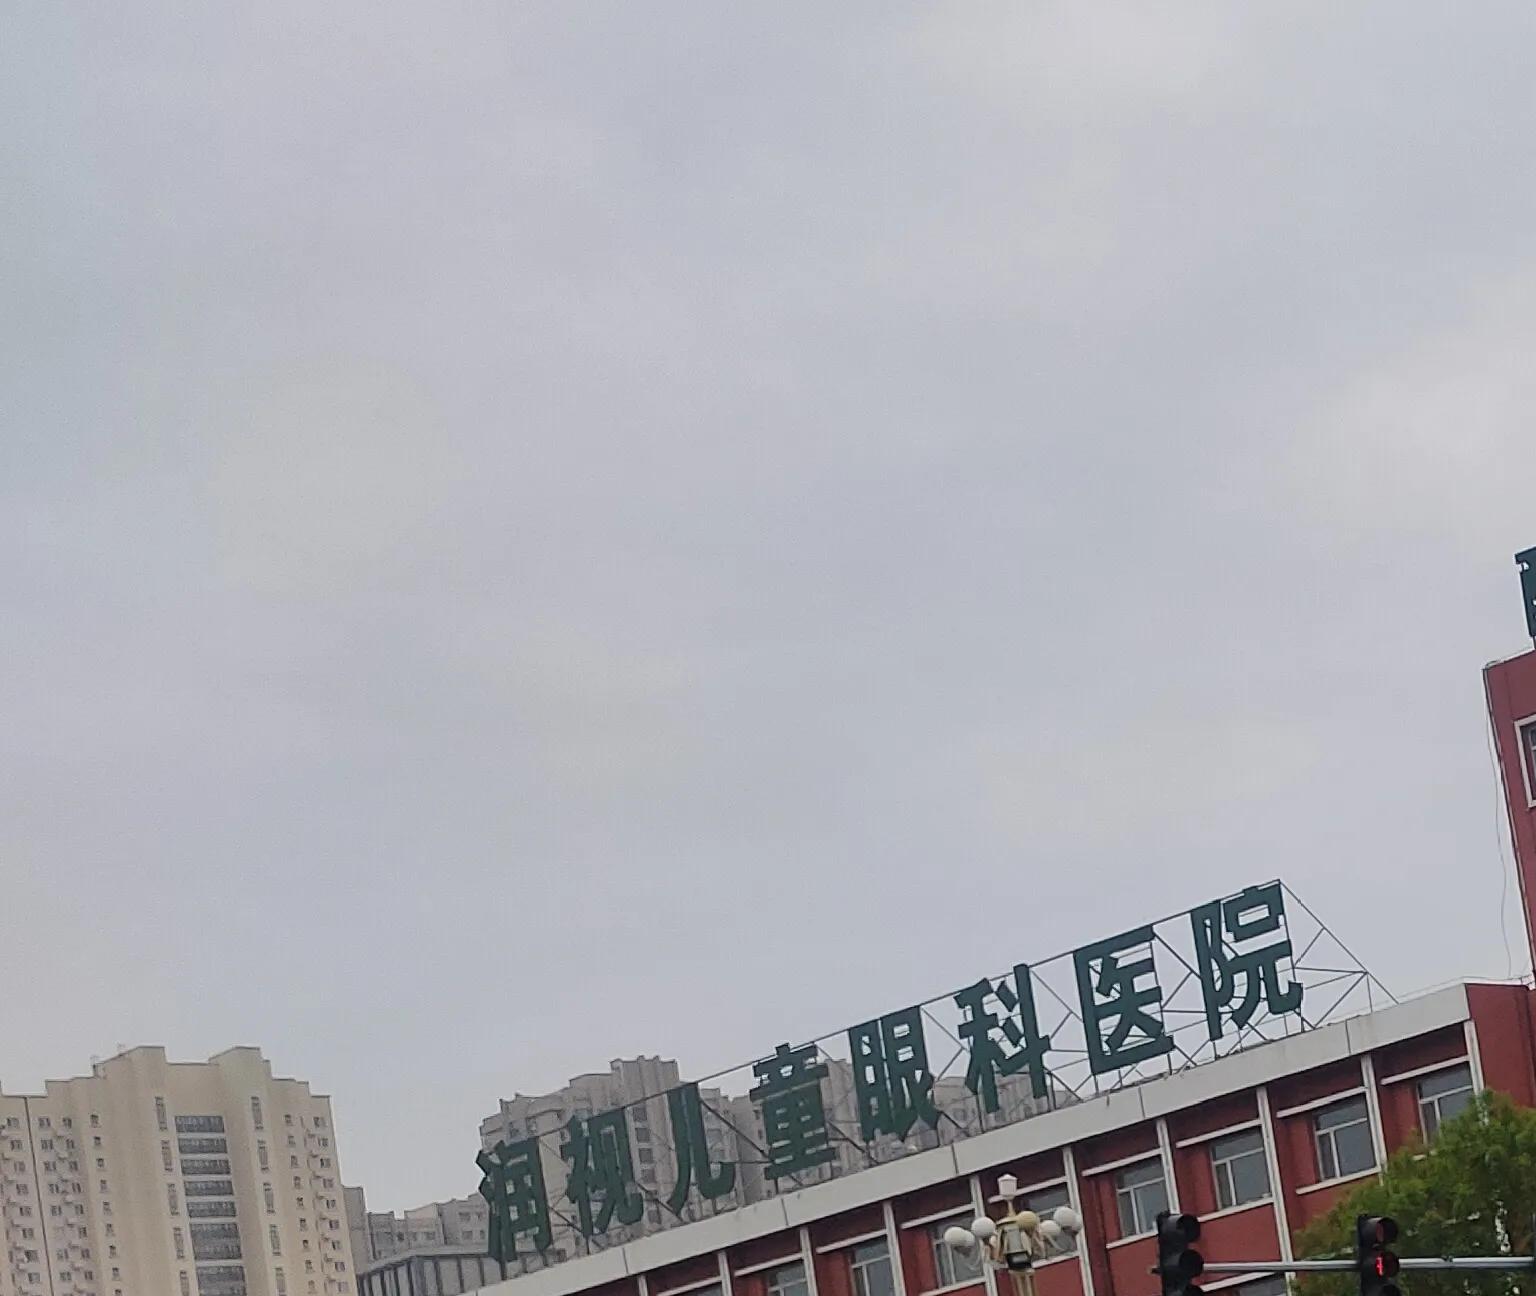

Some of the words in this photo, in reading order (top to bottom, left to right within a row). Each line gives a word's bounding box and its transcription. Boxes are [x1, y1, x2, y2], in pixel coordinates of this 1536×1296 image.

[474, 883, 1303, 1263] 润视儿童眼科医院
